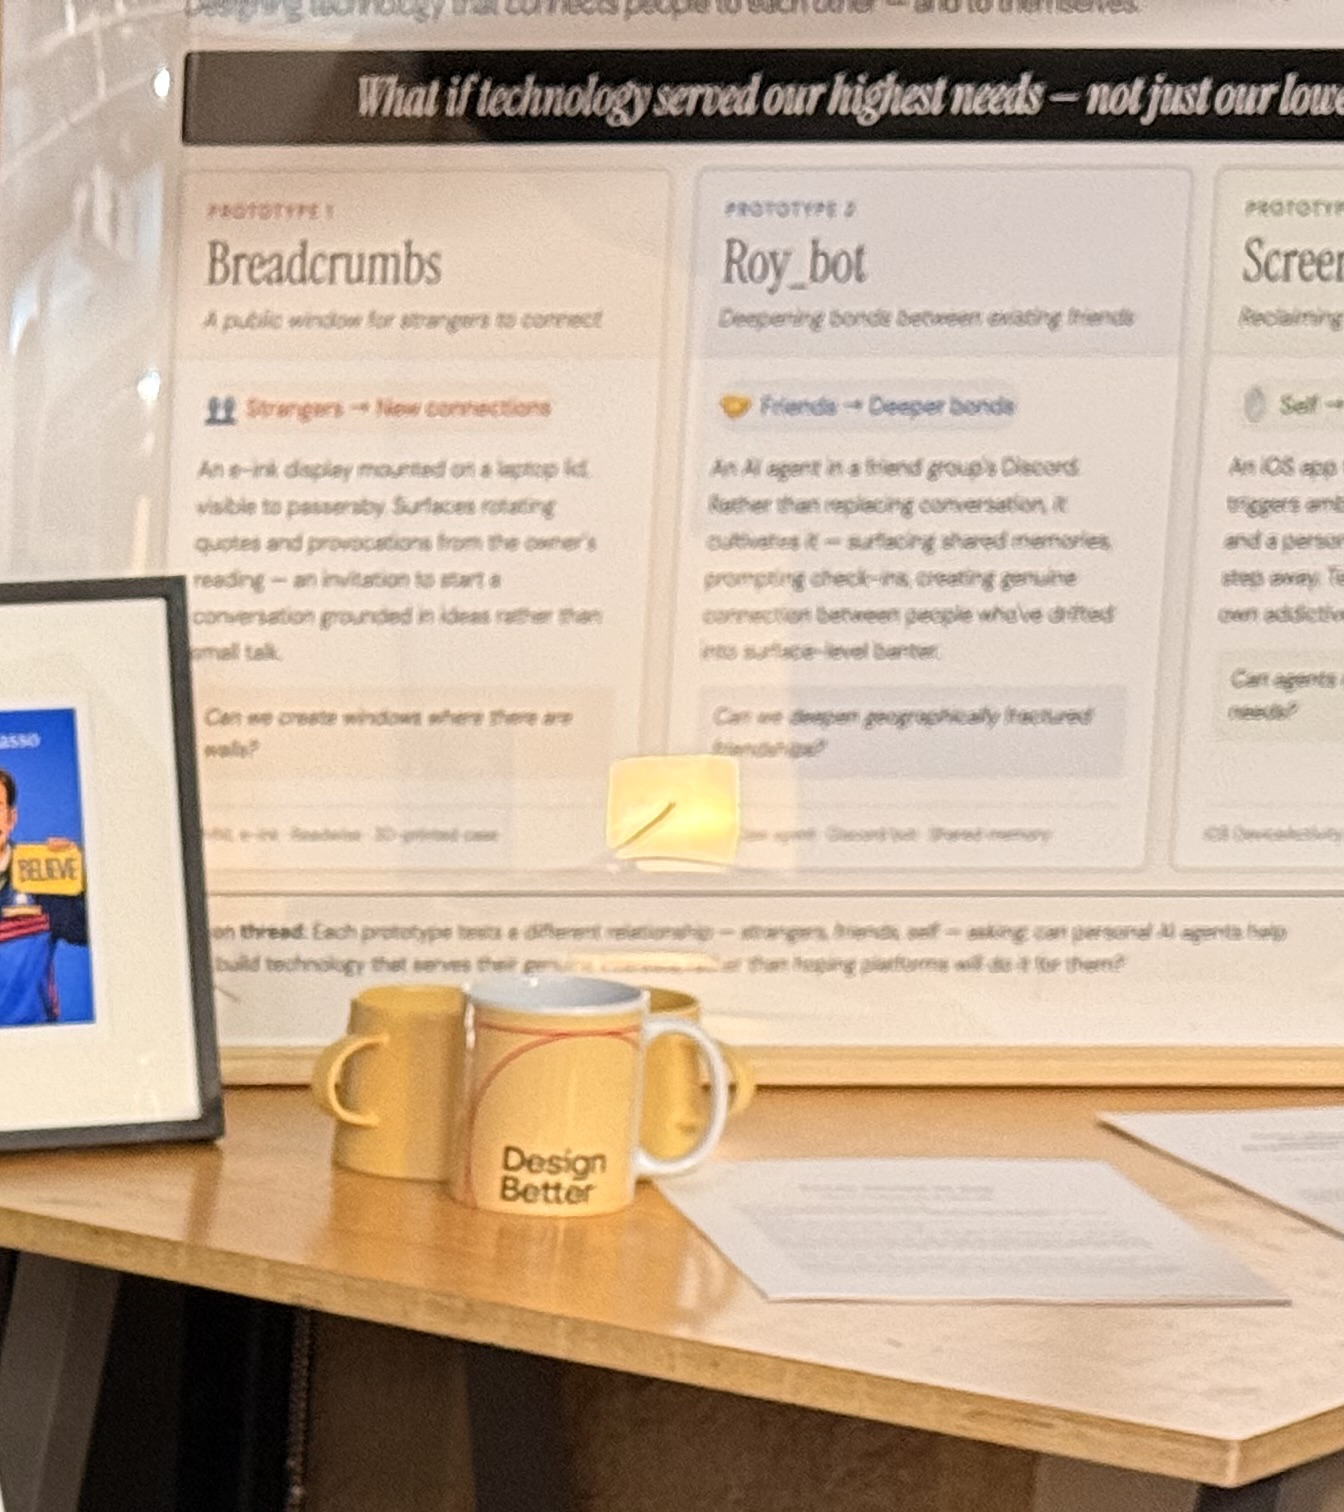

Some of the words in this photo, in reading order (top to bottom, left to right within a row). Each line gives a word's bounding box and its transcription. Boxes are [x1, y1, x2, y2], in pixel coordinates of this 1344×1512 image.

[358, 74, 439, 117] What
[446, 74, 475, 117] if
[477, 74, 651, 127] technology
[654, 73, 760, 116] served
[764, 84, 827, 115] our
[832, 72, 946, 126] highest
[951, 72, 1045, 115] needs
[1086, 78, 1144, 120] not
[1140, 74, 1212, 125] just
[1215, 84, 1277, 115] our
[207, 202, 320, 220] PROTOTYPE
[725, 200, 837, 218] PROTOTYPE
[206, 239, 442, 285] Breadcrumbs
[722, 238, 869, 295] Roy_bot
[246, 399, 344, 424] Strangers
[375, 400, 419, 417] New
[425, 400, 552, 418] connections
[760, 395, 839, 416] Friends
[868, 396, 945, 420] Deeper
[949, 397, 1016, 416] bonds
[17, 858, 79, 882] BELIEVE
[501, 1145, 607, 1183] Design
[499, 1173, 597, 1204] Better
